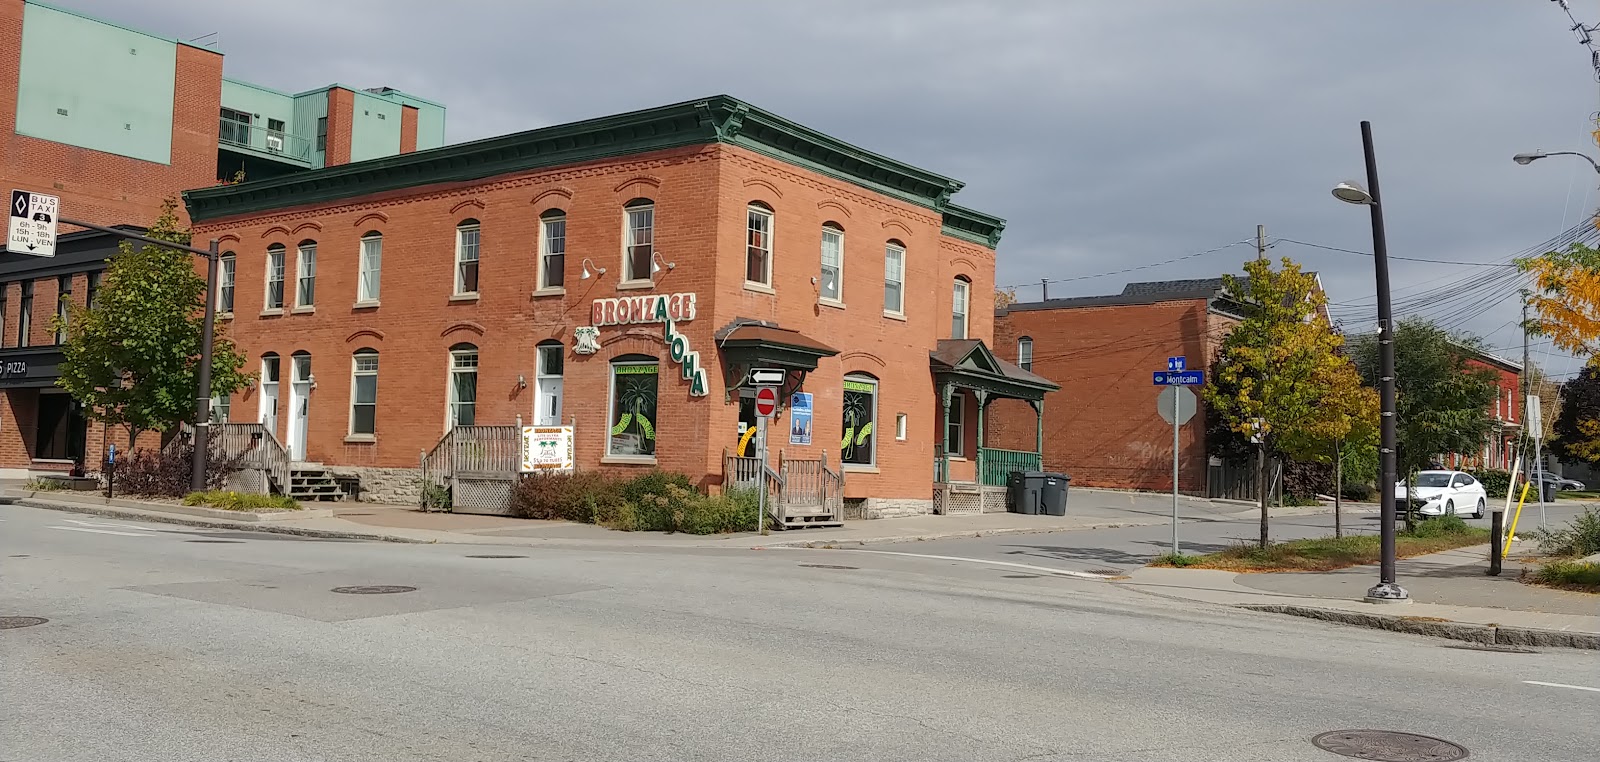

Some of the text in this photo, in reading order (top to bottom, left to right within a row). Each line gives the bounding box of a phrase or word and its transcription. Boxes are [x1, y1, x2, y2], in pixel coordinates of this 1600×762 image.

[31, 195, 56, 206] BUS
[31, 203, 55, 214] TAXI
[36, 223, 47, 231] 9h
[16, 228, 30, 236] 15h
[36, 231, 50, 239] 18h
[11, 235, 29, 243] LUN
[36, 238, 53, 247] VEN
[593, 294, 694, 325] BRONZAGE
[656, 296, 706, 395] ALOHA
[7, 362, 26, 374] PIZZA
[1166, 375, 1198, 384] Montcalm
